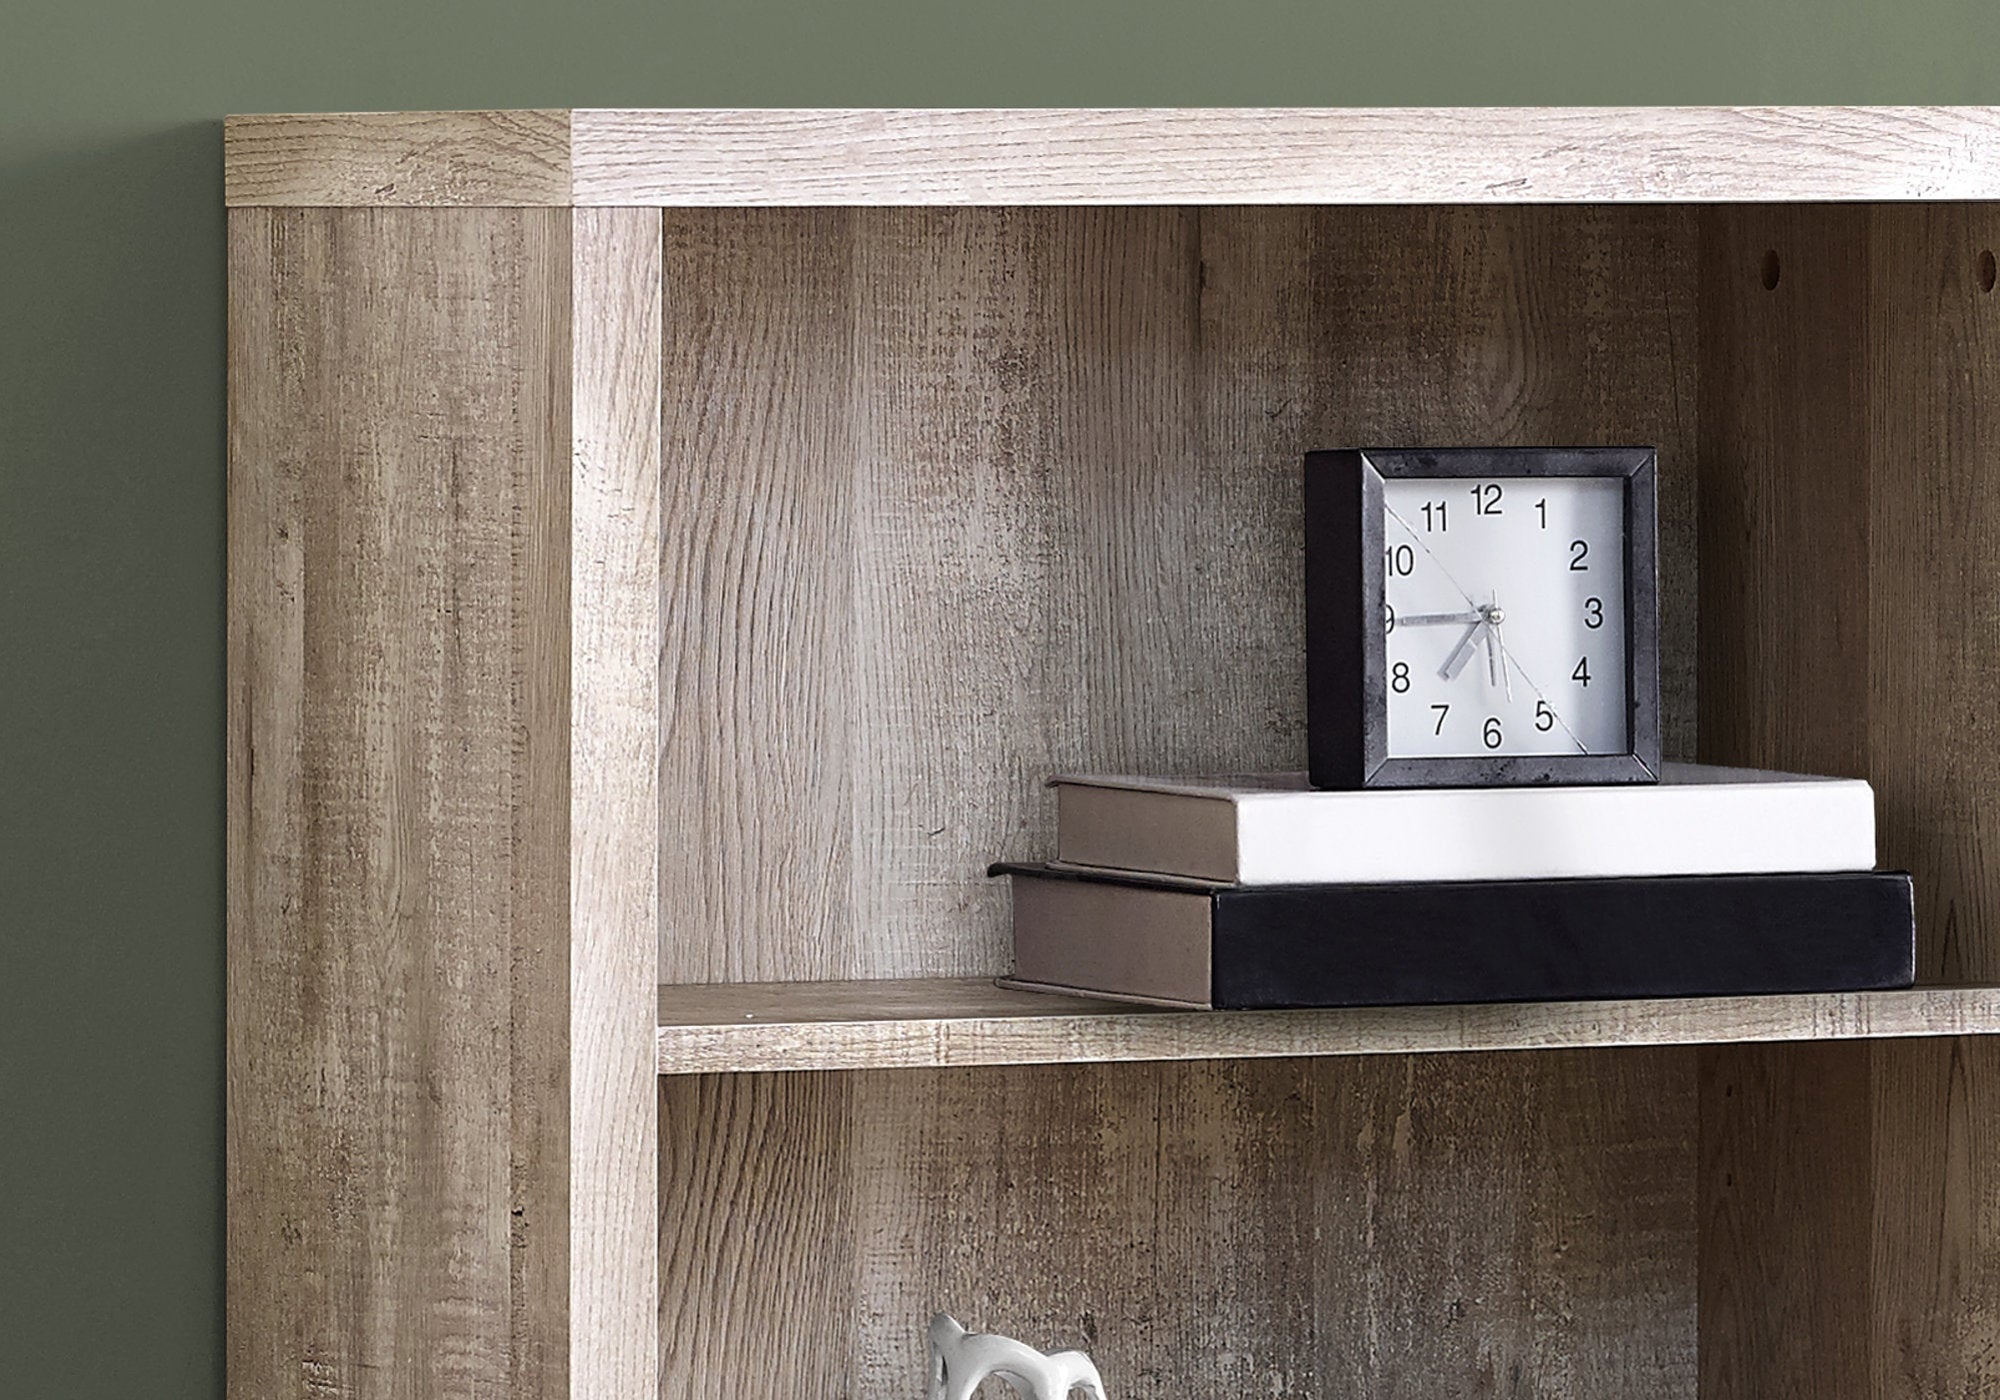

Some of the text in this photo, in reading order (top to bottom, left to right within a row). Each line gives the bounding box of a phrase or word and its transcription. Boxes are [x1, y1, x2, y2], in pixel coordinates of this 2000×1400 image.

[1470, 484, 1503, 515] 12
[1534, 498, 1546, 529] 1
[1420, 501, 1447, 532] 11
[1386, 545, 1414, 576] 10
[1569, 540, 1589, 571] 2
[1584, 597, 1604, 629] 3
[1391, 662, 1411, 693] 8
[1571, 656, 1592, 688] 4
[1430, 704, 1450, 736] 7
[1535, 700, 1554, 732] 5
[1483, 717, 1503, 749] 6
